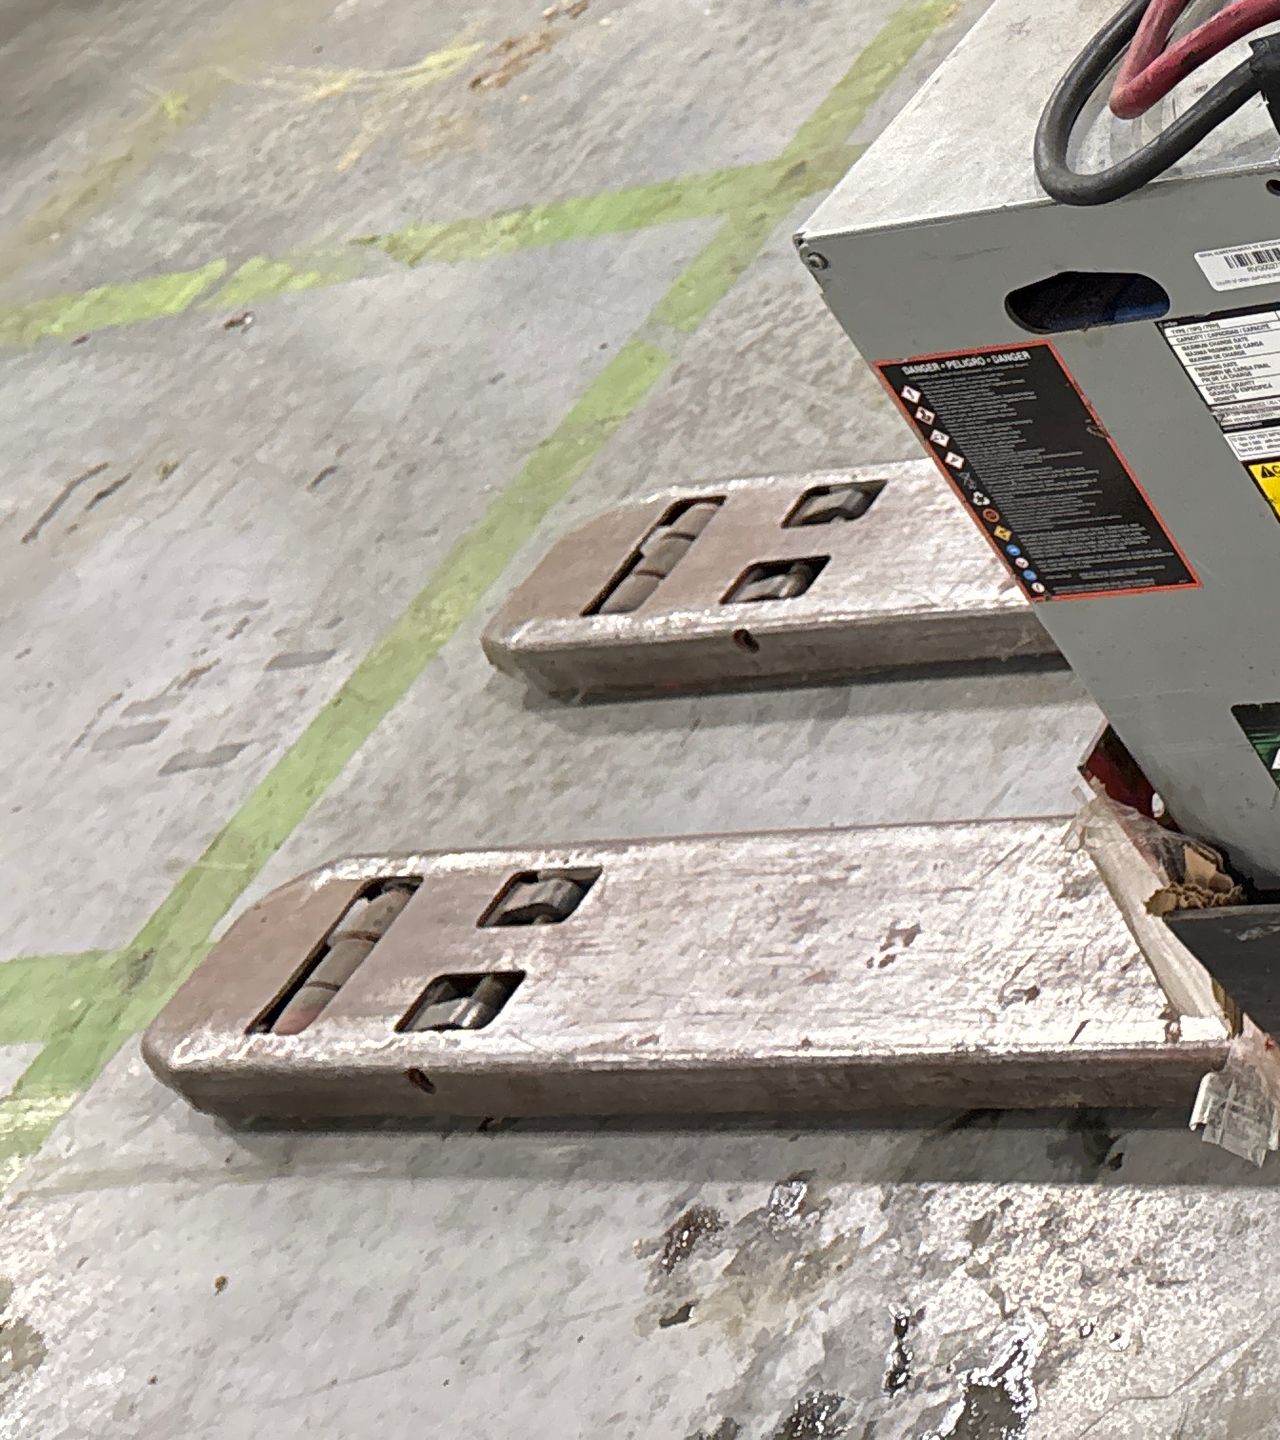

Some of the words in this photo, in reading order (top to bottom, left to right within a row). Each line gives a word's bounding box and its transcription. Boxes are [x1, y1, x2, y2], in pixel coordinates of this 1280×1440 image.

[901, 363, 941, 376] DANGER
[945, 356, 986, 371] PELIGRO
[991, 350, 1031, 365] DANGER
